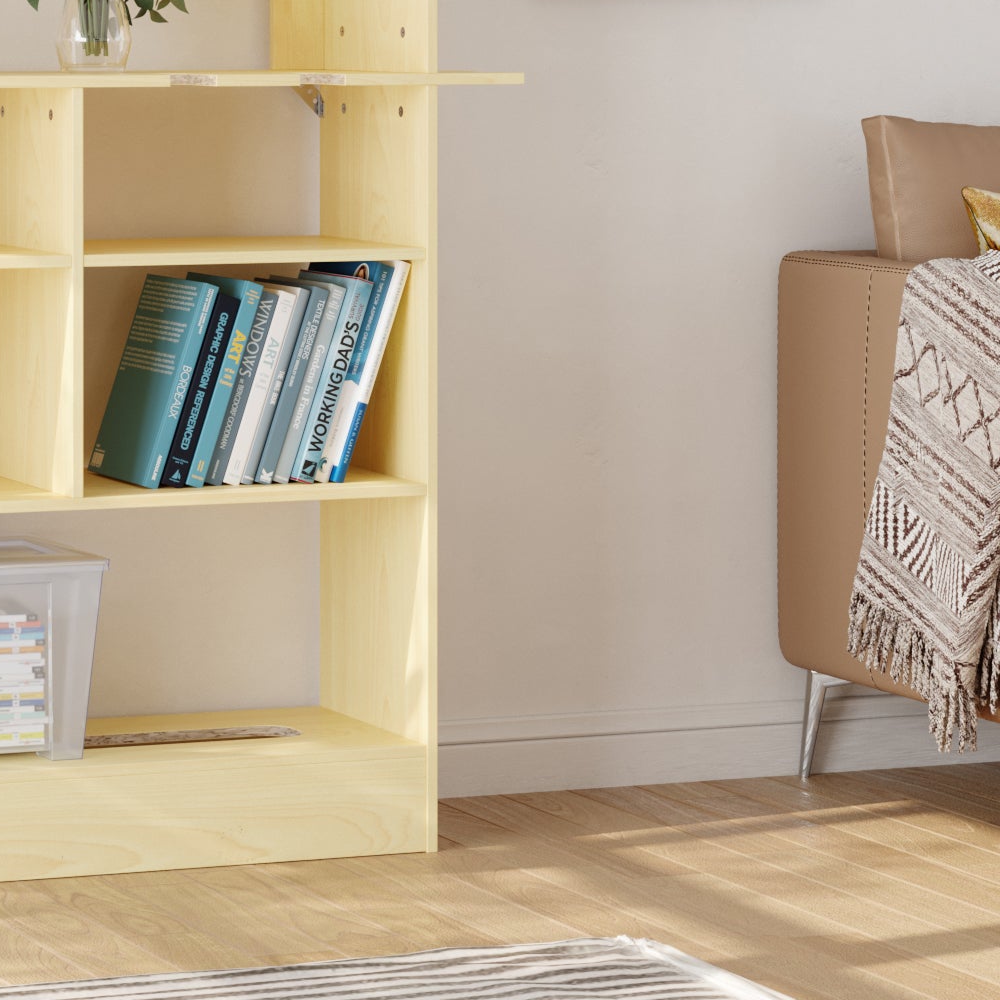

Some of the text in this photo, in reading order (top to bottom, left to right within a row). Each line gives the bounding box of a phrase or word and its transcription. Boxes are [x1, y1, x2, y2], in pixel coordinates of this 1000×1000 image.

[209, 311, 230, 354] GRAPHIC
[226, 329, 249, 365] ART
[237, 296, 274, 379] WINDOWS
[262, 337, 281, 369] ART
[301, 299, 325, 361] TEXTILE DESIGNERS
[167, 364, 193, 420] BORDEAUX
[198, 354, 217, 390] DESIGN
[292, 344, 326, 431] Gardens in France
[307, 370, 345, 455] WORKING
[332, 320, 360, 372] DAD'S
[179, 389, 206, 452] REFERENCED
[229, 384, 245, 417] BERGDORF
[219, 416, 235, 450] GOODMAN
